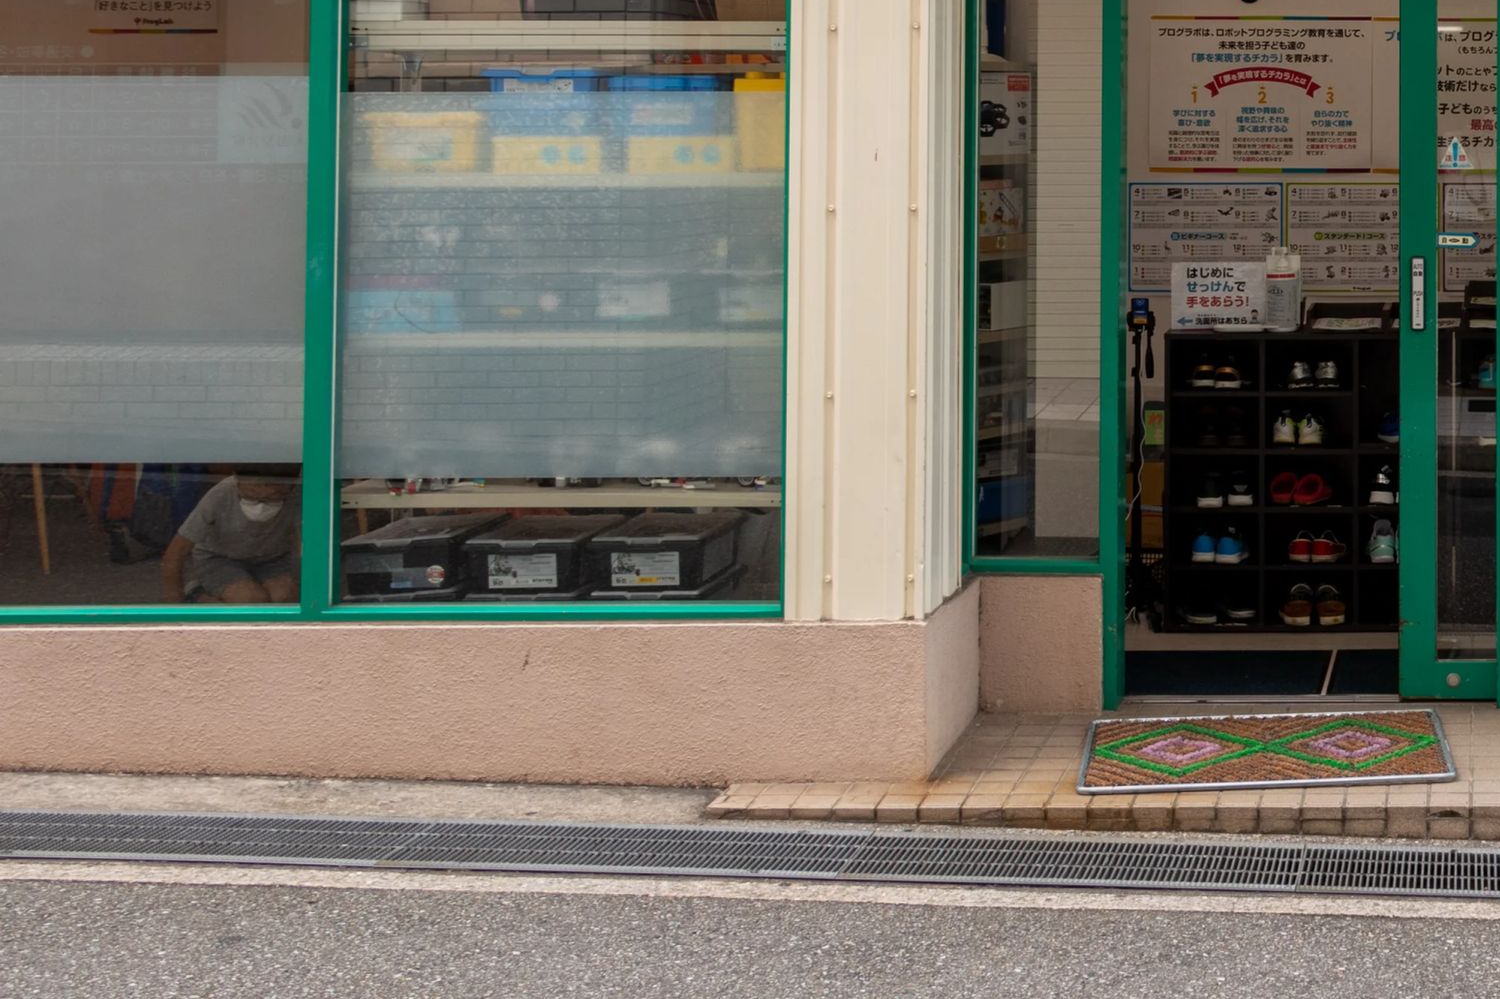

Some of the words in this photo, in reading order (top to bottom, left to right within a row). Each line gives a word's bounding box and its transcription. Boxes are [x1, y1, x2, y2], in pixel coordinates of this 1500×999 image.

[1258, 91, 1267, 104] 2
[1326, 91, 1334, 104] 3
[1186, 267, 1234, 279] はじめに
[1186, 281, 1246, 293] せっけんで
